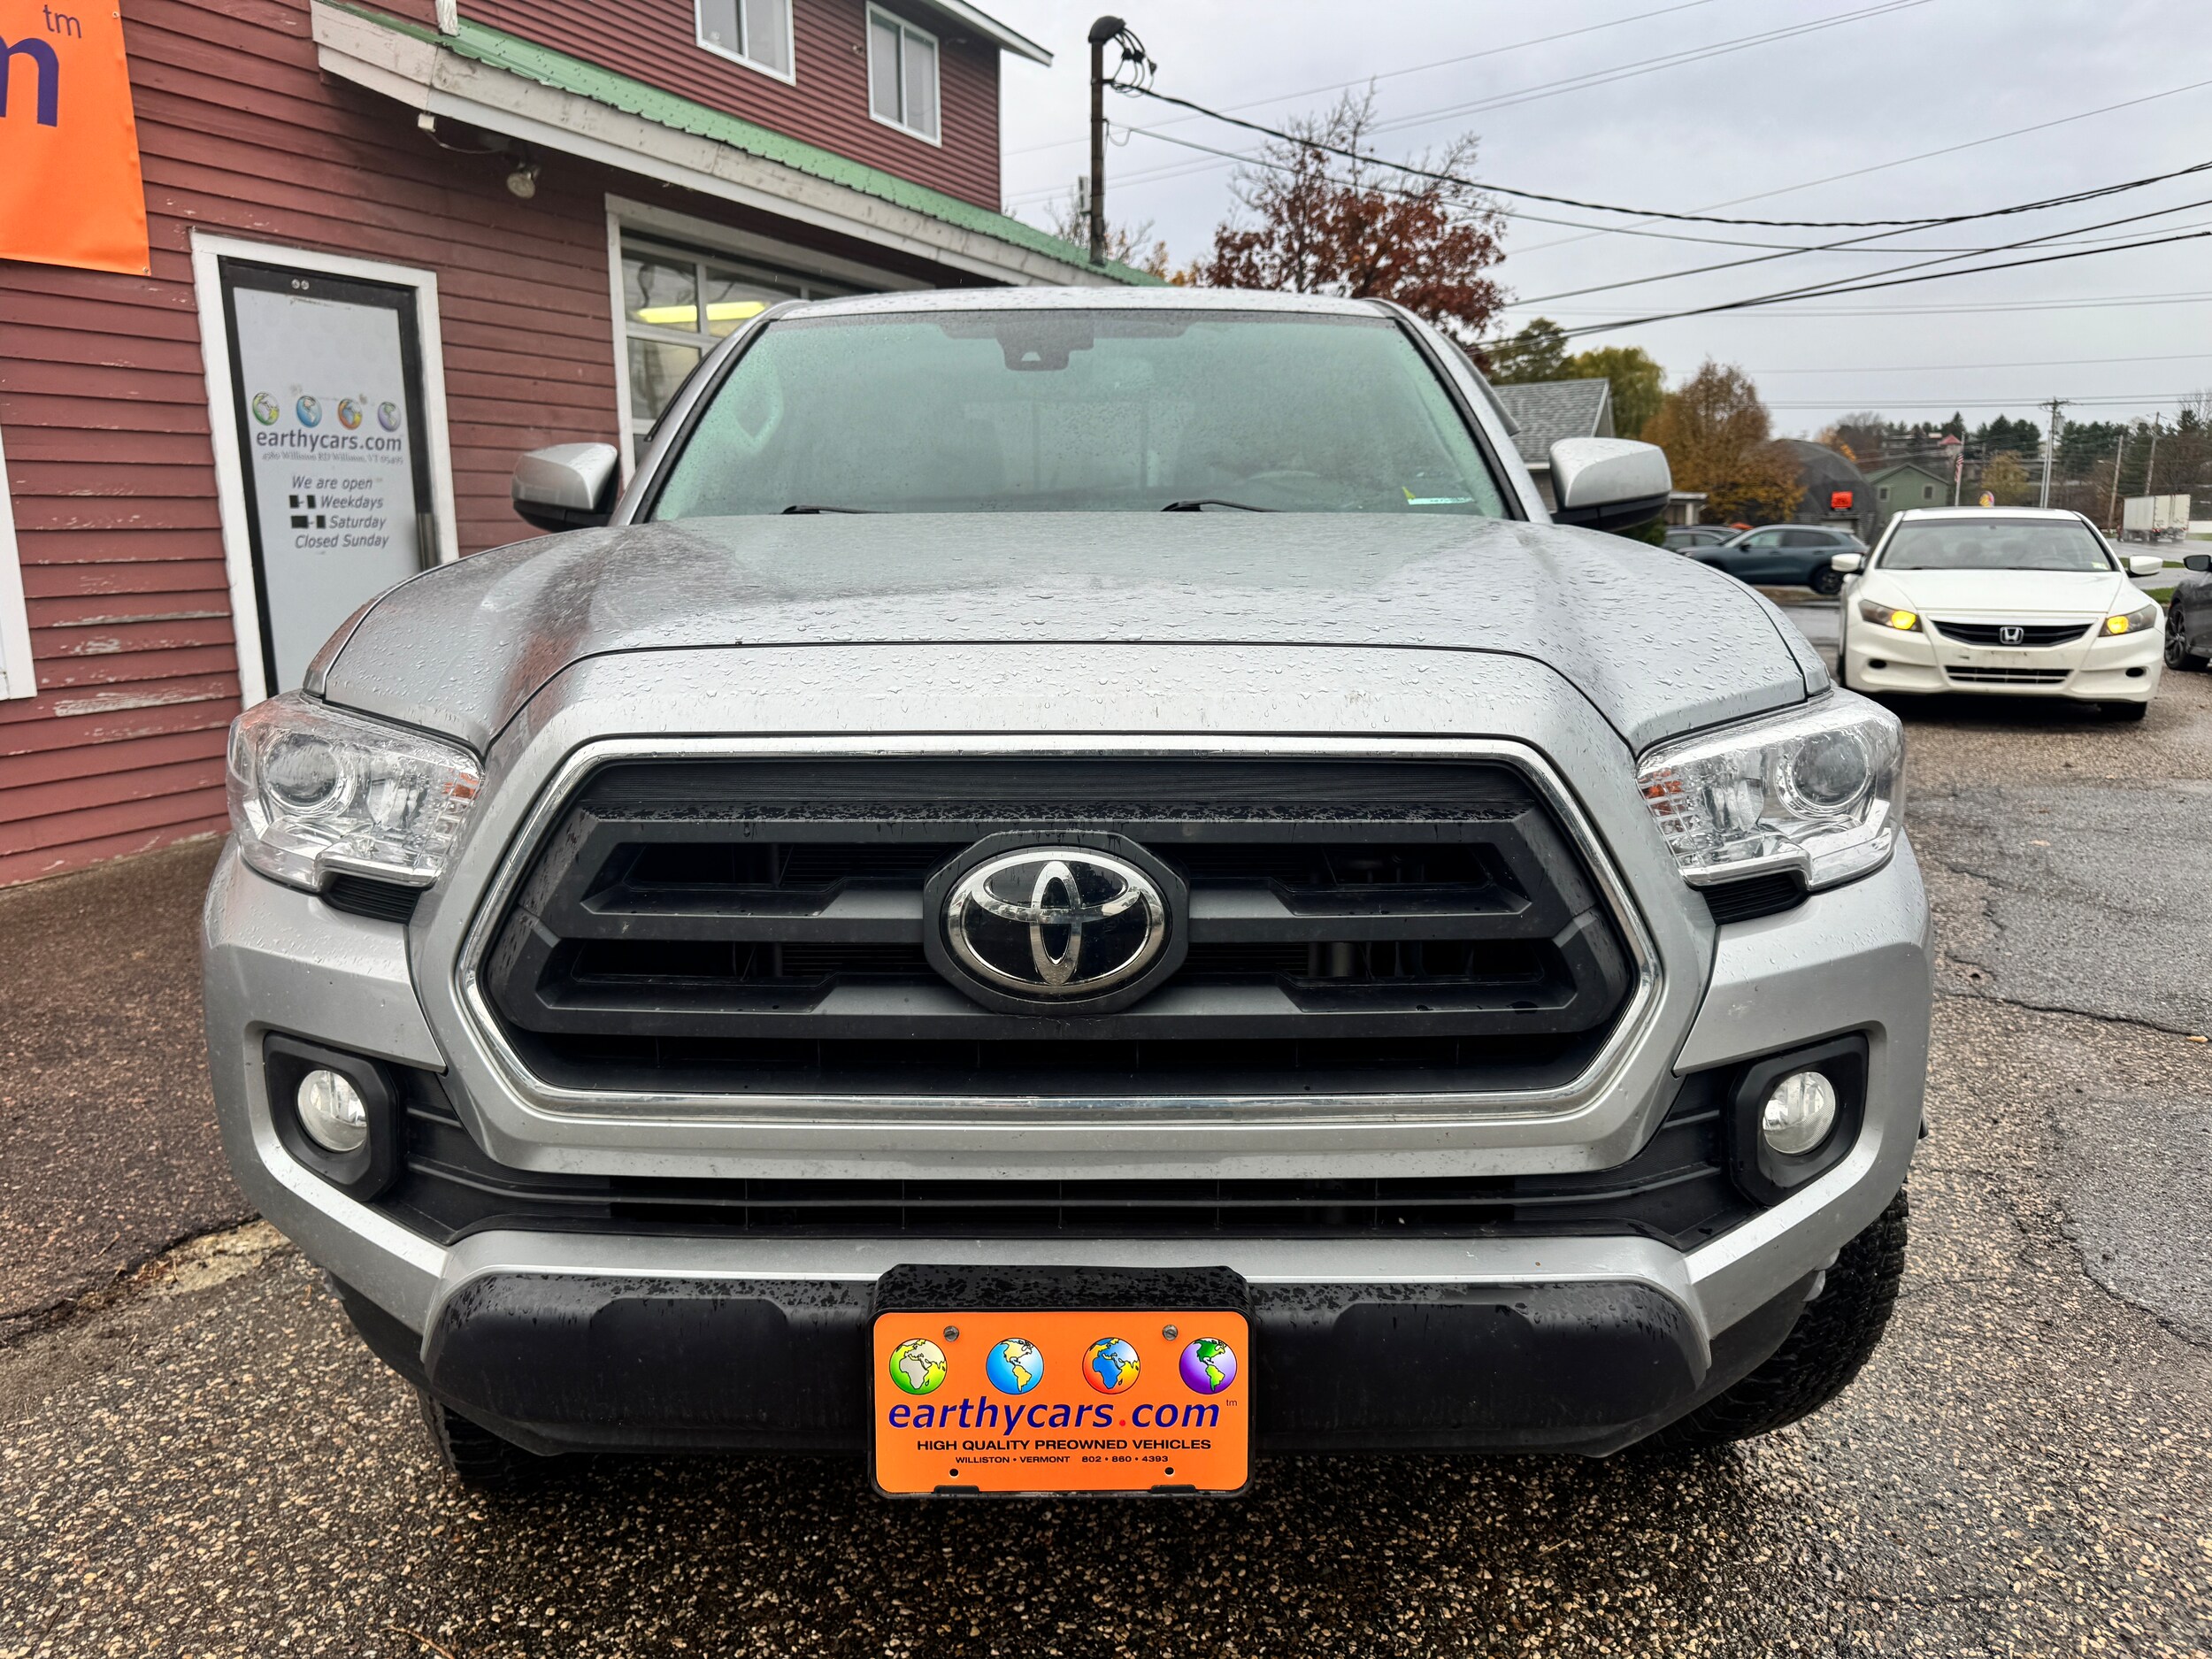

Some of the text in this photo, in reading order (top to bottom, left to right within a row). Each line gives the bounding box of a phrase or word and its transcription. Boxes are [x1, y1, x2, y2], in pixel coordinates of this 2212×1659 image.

[42, 4, 81, 38] tm
[256, 429, 402, 452] earthycars.com
[292, 475, 373, 492] We are open
[320, 495, 384, 511] Weekdays
[328, 515, 387, 530] Saturday
[295, 534, 389, 549] Closed Sunday
[888, 1395, 1220, 1436] earthycars.com
[917, 1439, 1211, 1452] HIGH QUALITY PREOWNED VEHICLES
[955, 1455, 1010, 1464] WILLISTON
[1141, 1455, 1169, 1463] 4393
